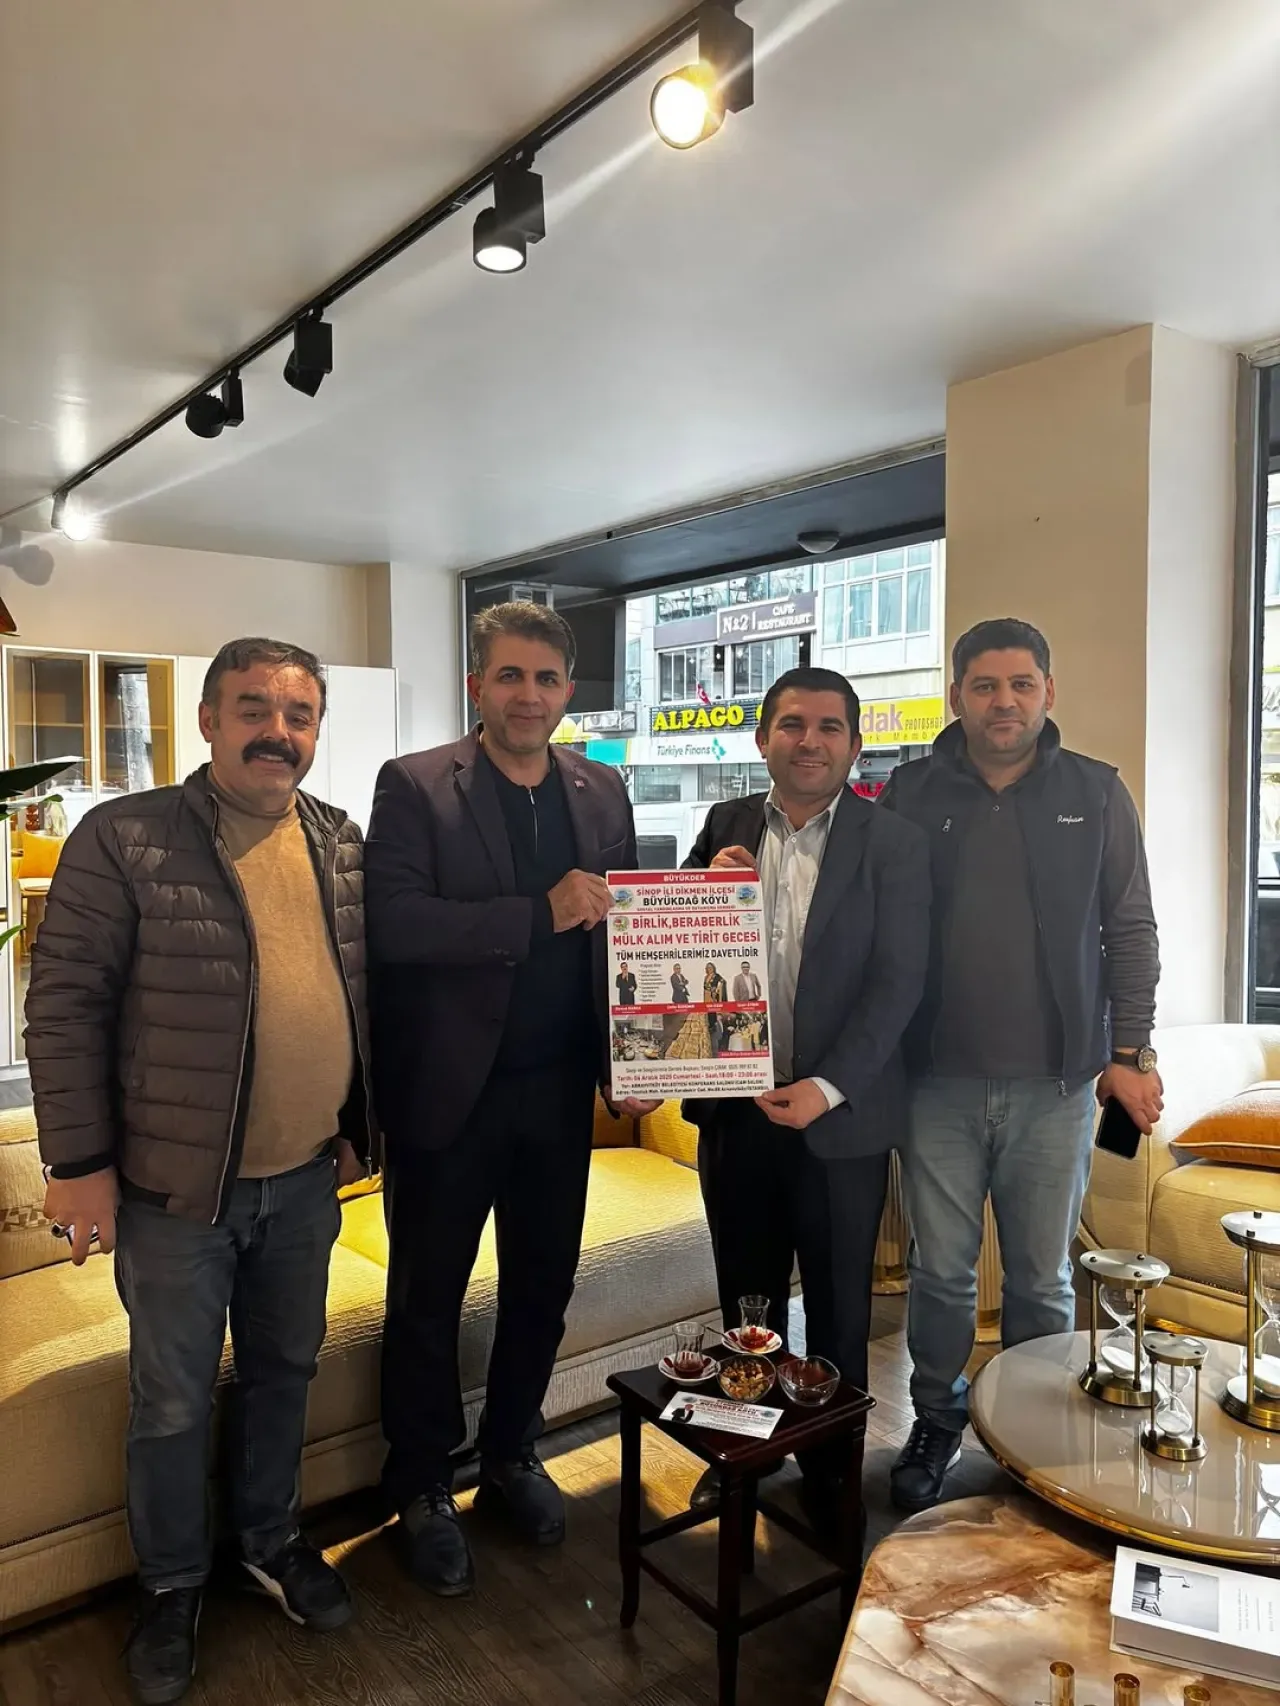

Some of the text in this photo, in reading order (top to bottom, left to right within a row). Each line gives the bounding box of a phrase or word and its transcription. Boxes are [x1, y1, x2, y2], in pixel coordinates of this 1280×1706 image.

[757, 612, 812, 631] RESTAURANT
[653, 704, 744, 731] ALPAGO
[861, 704, 903, 732] dak
[657, 744, 711, 757] Türkiye Finans
[663, 874, 706, 882] BÜYÜKDER
[636, 885, 736, 896] SİNOP İLİ DİKMEN İLÇESİ
[643, 894, 729, 906] BÜYÜKDAĞ KÖYÜ
[613, 928, 761, 946] MÜLK ALIM VE TİRİT GECESİ
[616, 946, 759, 961] TÜM HEMŞEHRİLERİMİZ DAVETLİDİR
